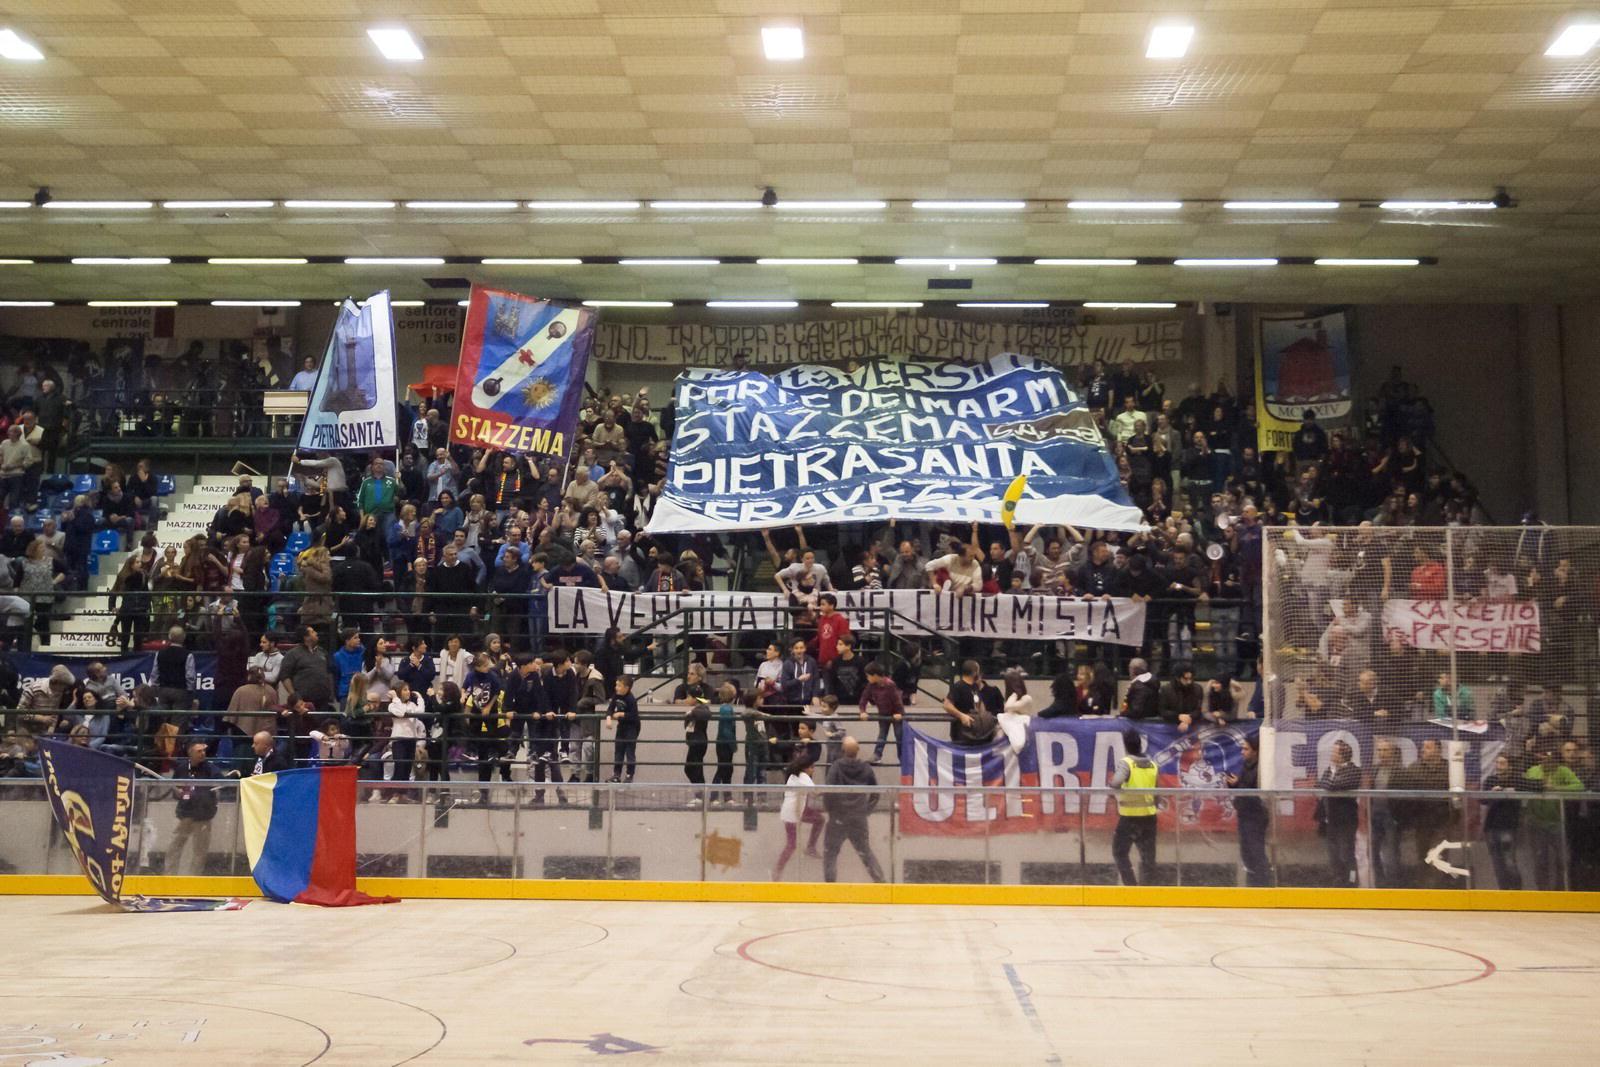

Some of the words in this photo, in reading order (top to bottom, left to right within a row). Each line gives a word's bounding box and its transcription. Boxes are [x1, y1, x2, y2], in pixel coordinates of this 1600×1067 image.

[92, 317, 151, 329] centrale
[398, 317, 457, 330] centrale
[405, 304, 457, 317] settore
[666, 326, 693, 346] IN
[700, 324, 770, 346] COPPA
[774, 323, 786, 346] E
[793, 315, 930, 344] CAMPIONATO
[1015, 325, 1088, 347] DERBY
[797, 342, 834, 361] CHE
[839, 334, 933, 358] CONTANO
[311, 421, 385, 448] PIETRASANTA
[456, 415, 564, 457] STAZZEMA
[676, 405, 984, 452] STAZZEMA
[674, 443, 1057, 496] PIETRASANTA
[201, 485, 237, 493] MAZZIN
[166, 521, 205, 529] MAZZINI
[553, 587, 589, 629] LA
[606, 590, 758, 630] VERSILIA
[845, 590, 904, 631] NEL
[916, 590, 998, 634] CUOR
[60, 633, 104, 641] MAZZINI
